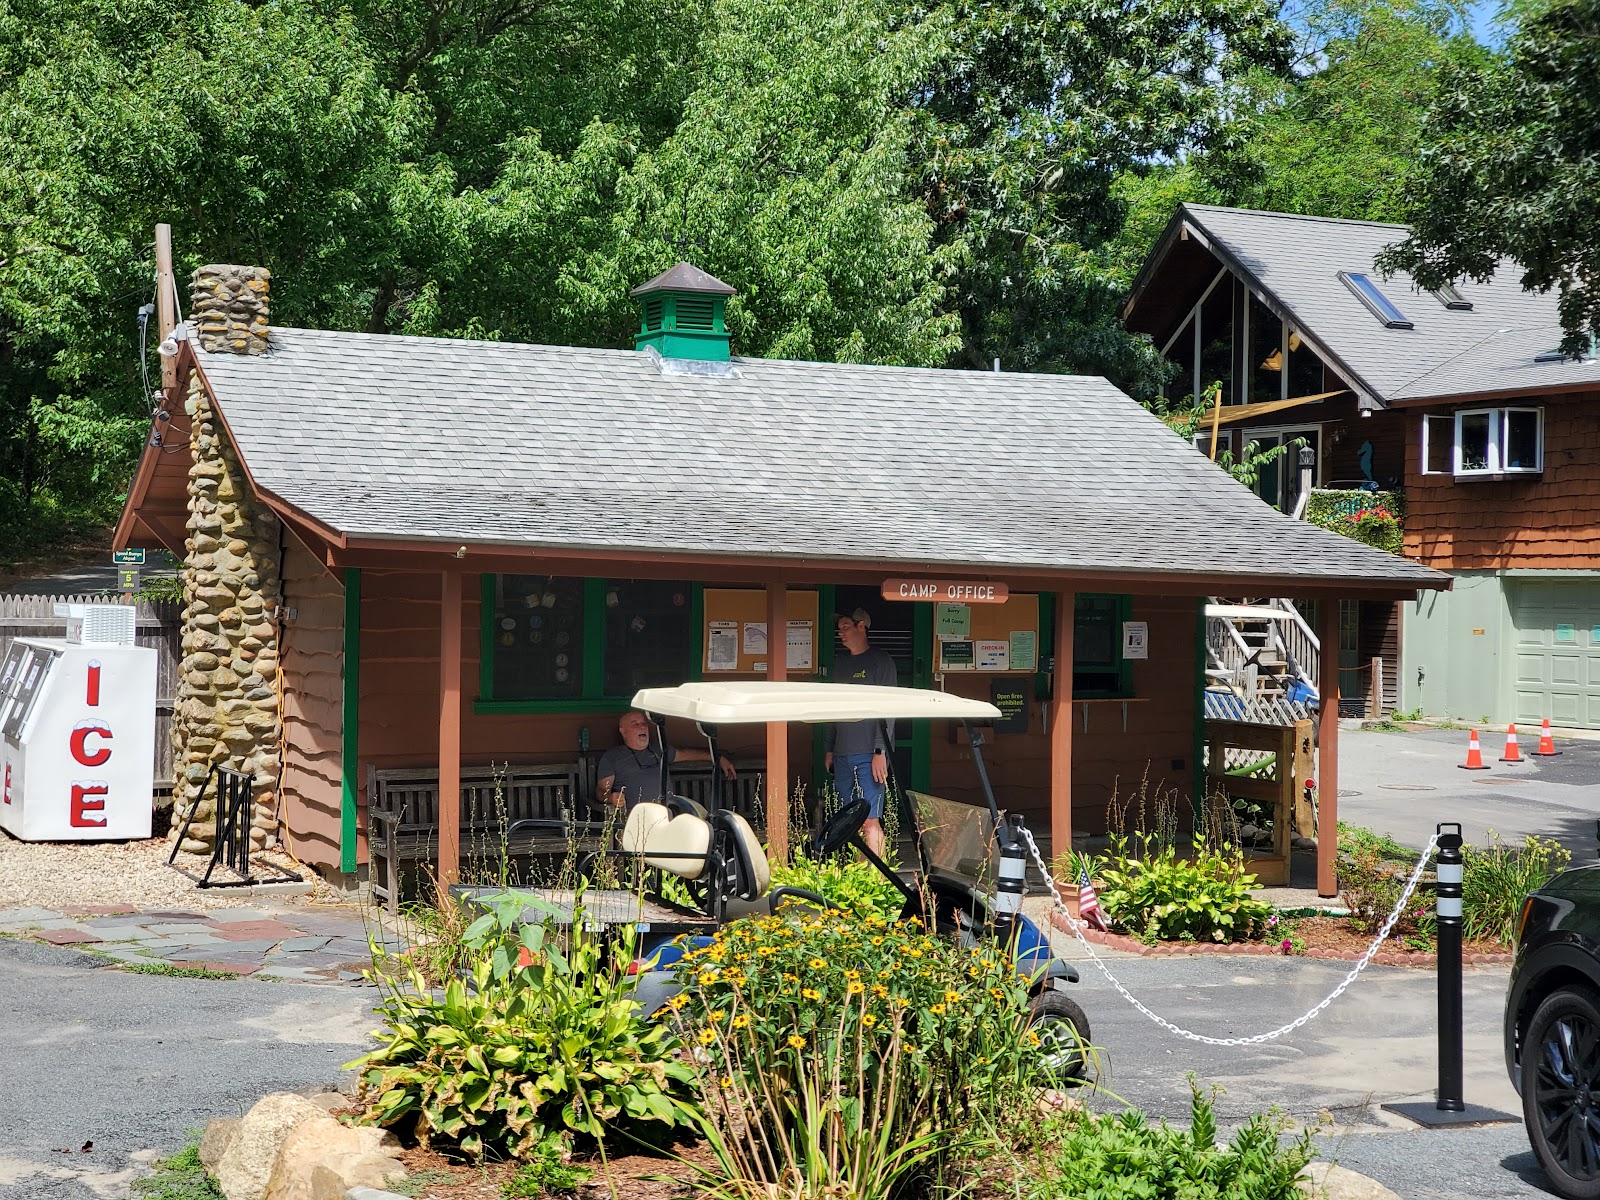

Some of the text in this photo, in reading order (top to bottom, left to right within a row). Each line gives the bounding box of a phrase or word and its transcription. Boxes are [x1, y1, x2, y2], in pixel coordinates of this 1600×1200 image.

[900, 584, 995, 600] CAMP OFFICE
[70, 658, 113, 828] ICE
